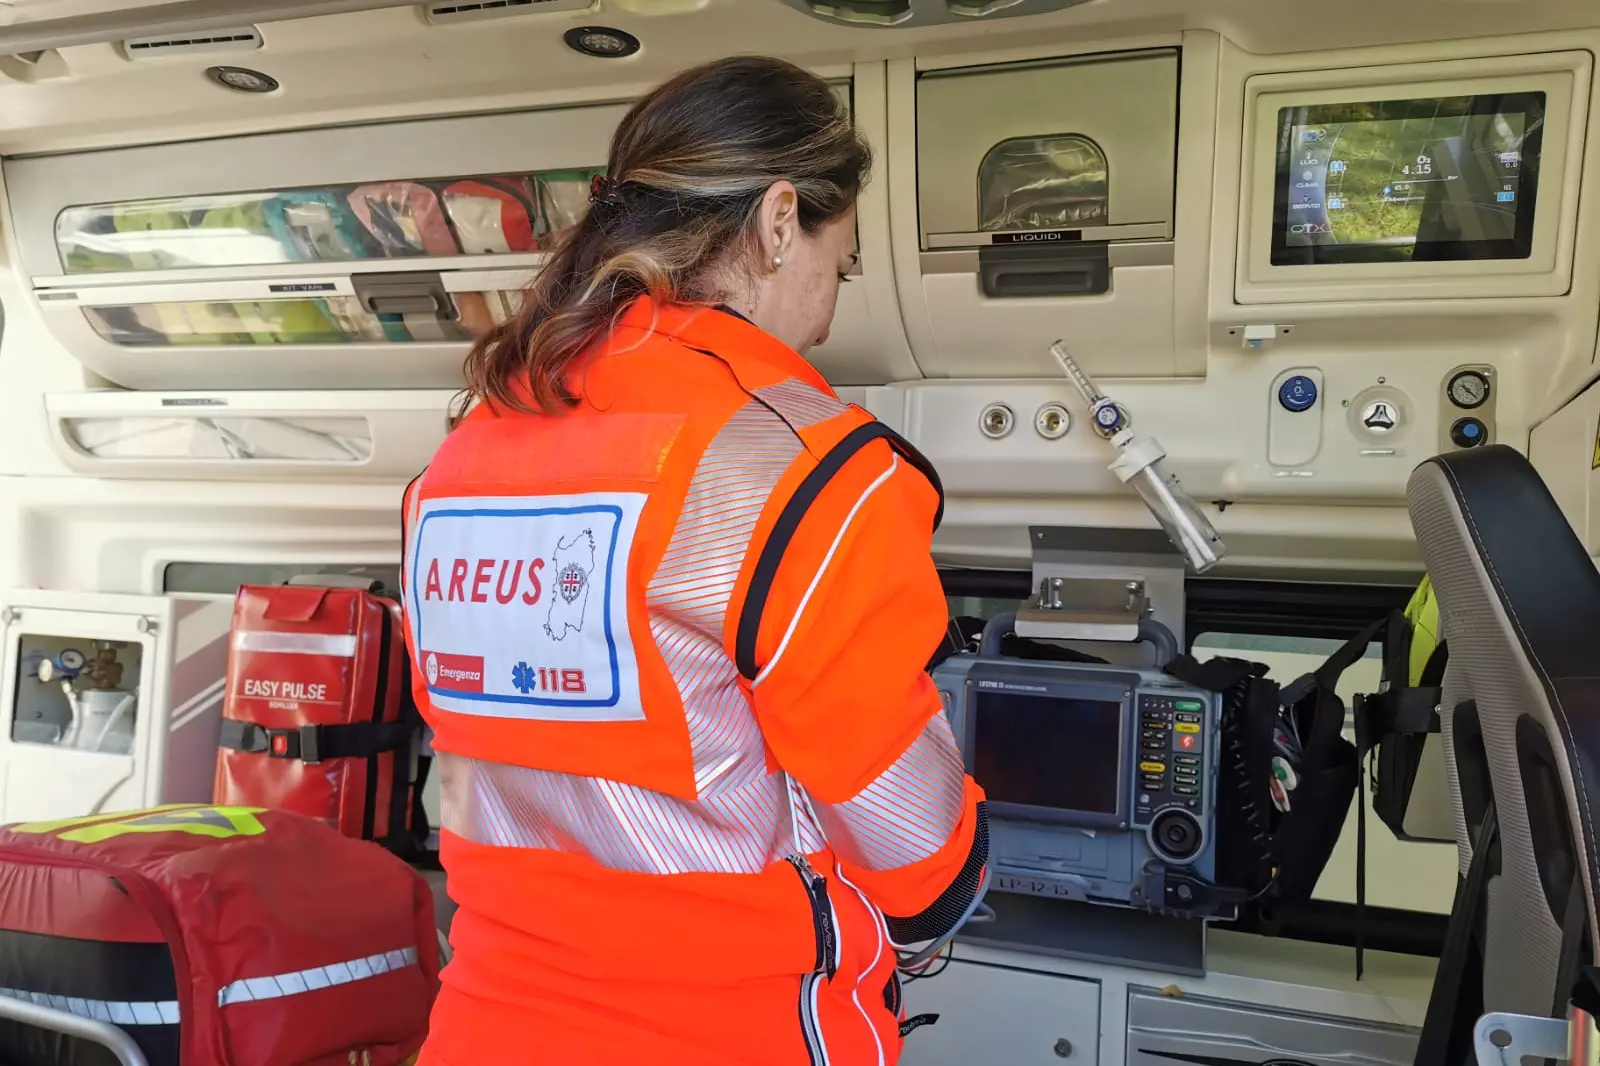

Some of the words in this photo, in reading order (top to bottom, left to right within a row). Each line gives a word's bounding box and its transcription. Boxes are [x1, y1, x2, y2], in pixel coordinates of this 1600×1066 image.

[1402, 164, 1431, 174] 4.15
[1012, 232, 1061, 242] LIQUIDI
[424, 557, 545, 606] AREUS
[439, 664, 481, 682] Emergenza
[538, 667, 587, 693] 118
[244, 679, 279, 697] EASY
[282, 681, 327, 700] PULSE
